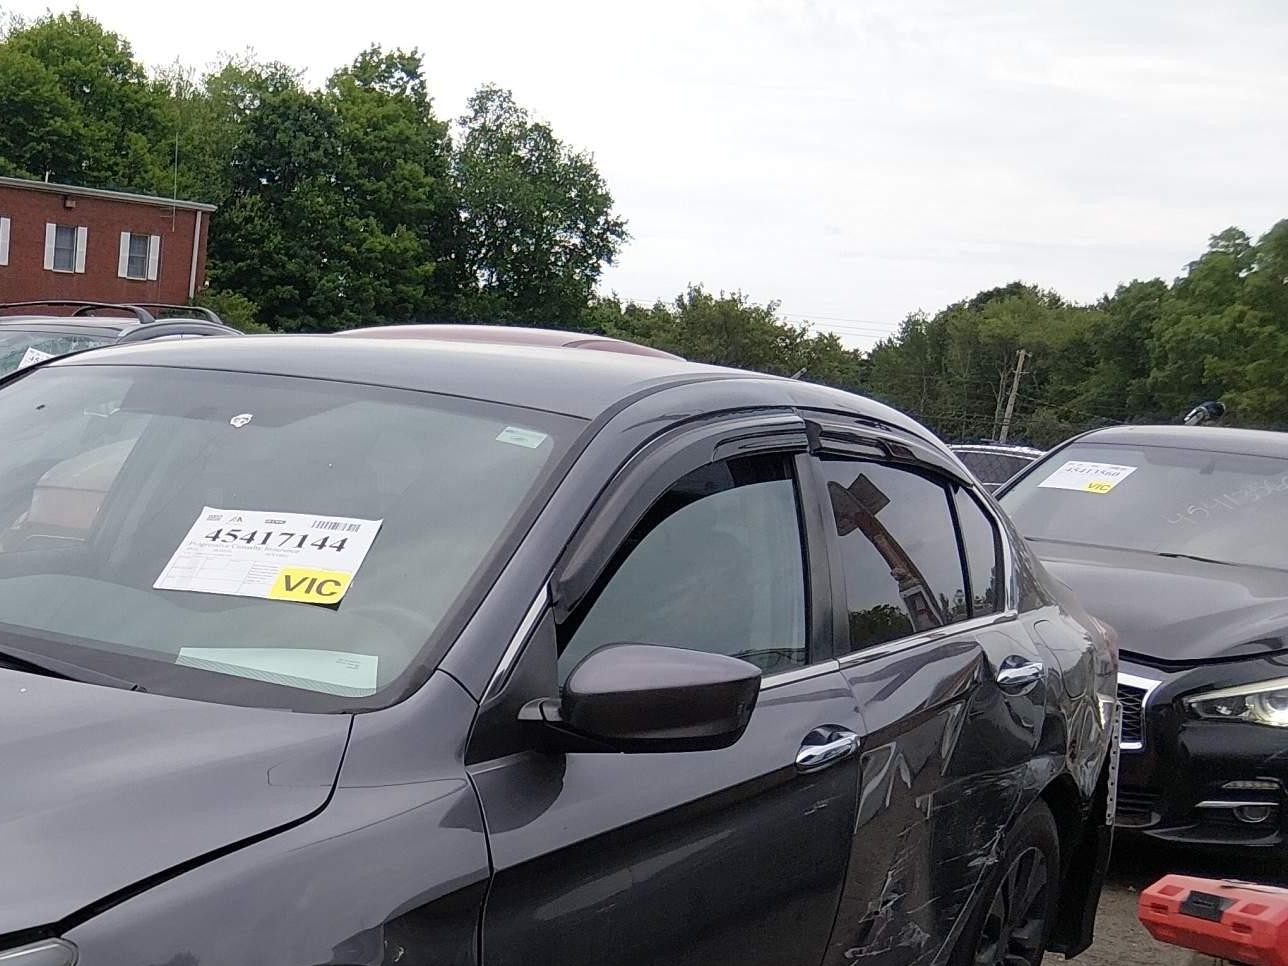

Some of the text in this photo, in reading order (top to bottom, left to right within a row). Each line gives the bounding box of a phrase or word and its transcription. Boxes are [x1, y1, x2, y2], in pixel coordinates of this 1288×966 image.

[1087, 482, 1111, 491] VIC
[204, 528, 349, 552] 45417144
[284, 575, 342, 597] VIC
